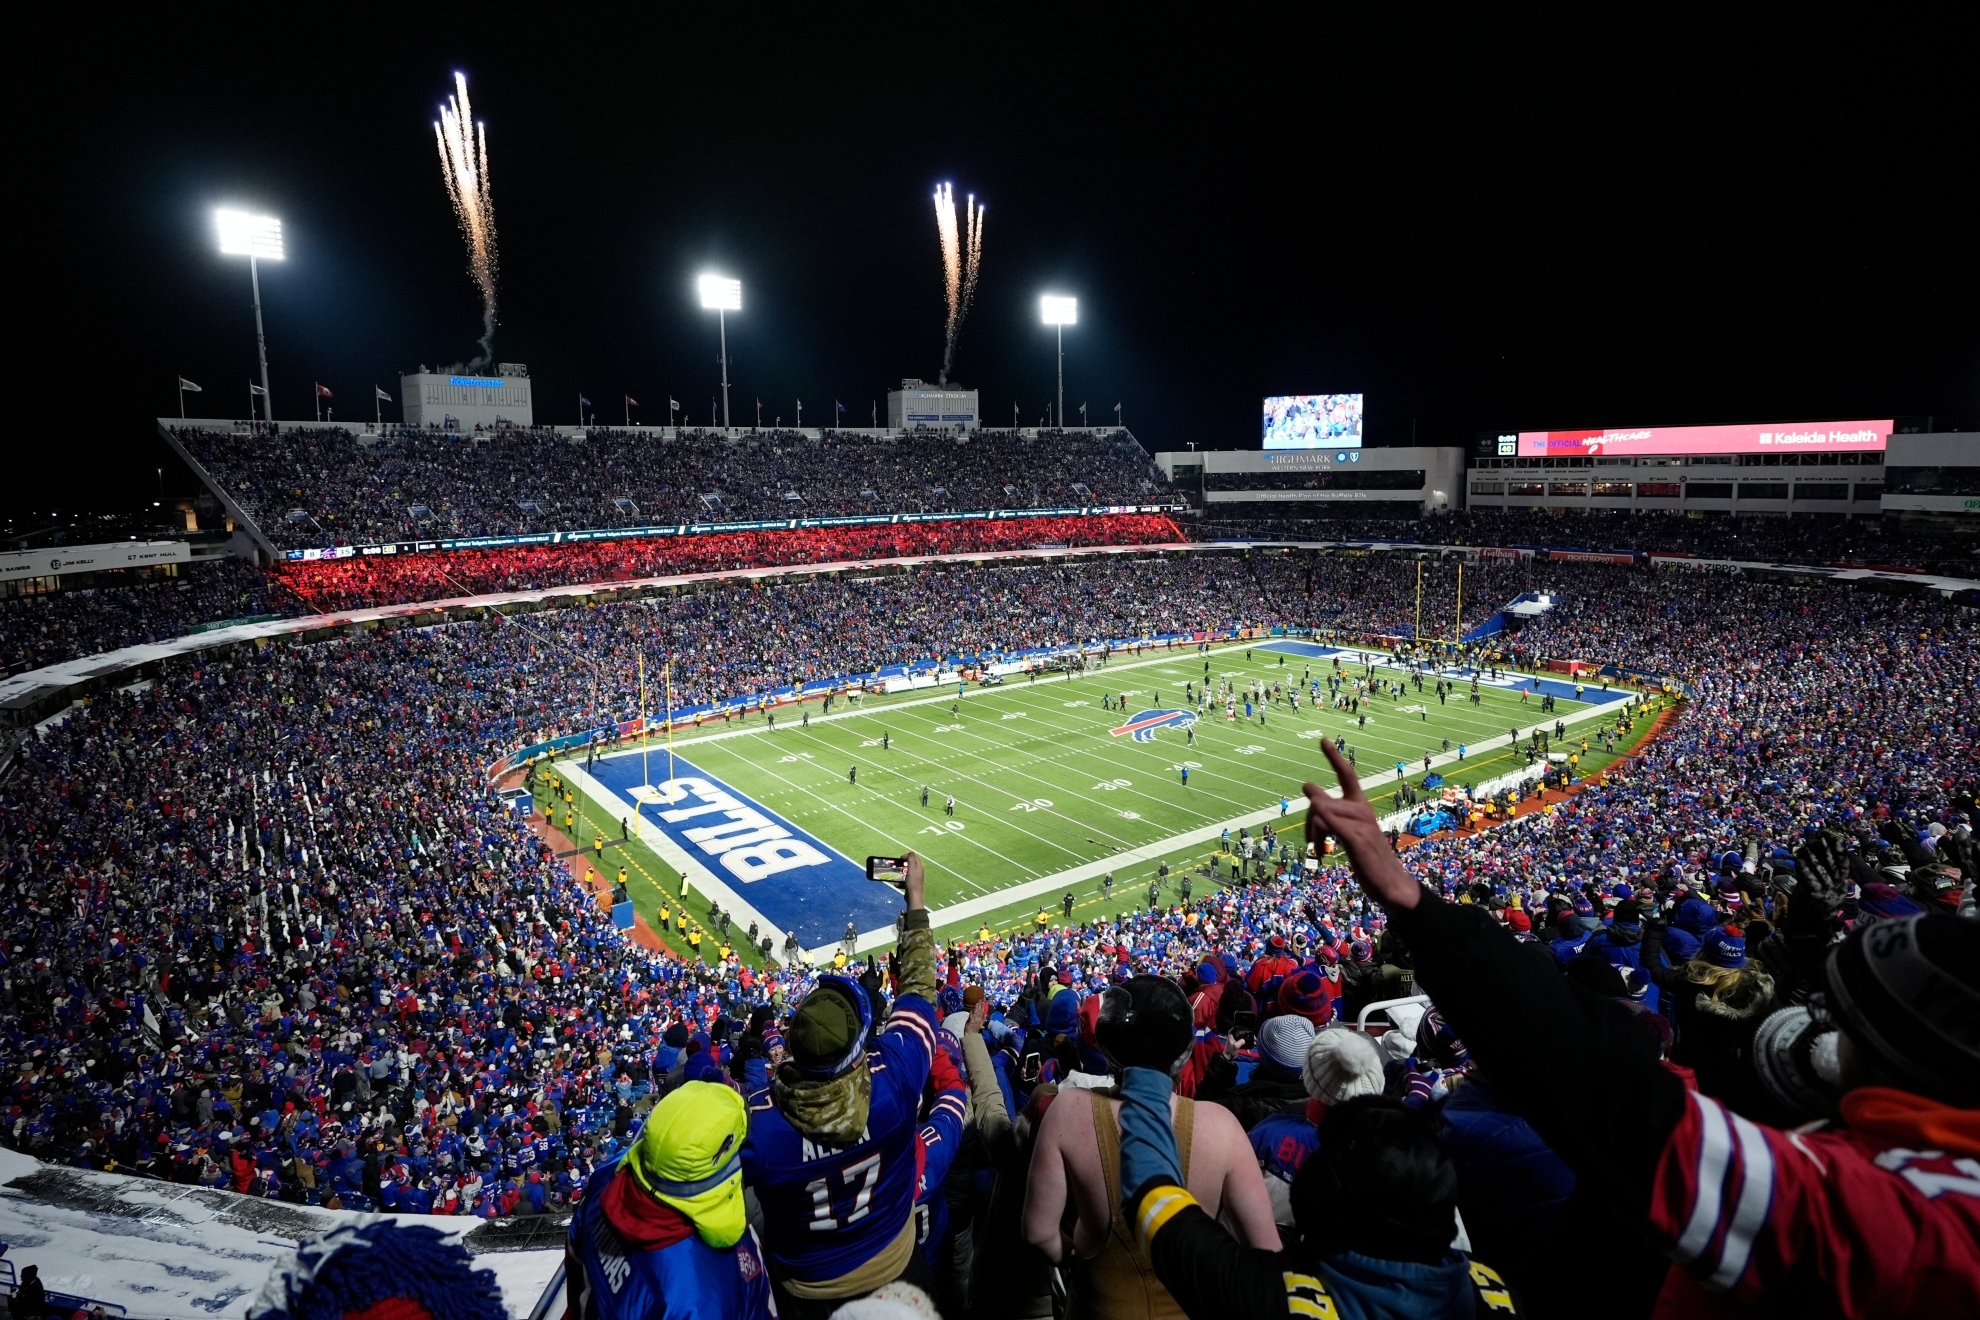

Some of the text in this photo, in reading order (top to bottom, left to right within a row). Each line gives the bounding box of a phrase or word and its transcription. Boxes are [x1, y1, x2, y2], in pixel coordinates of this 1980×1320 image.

[450, 377, 504, 387] ticketmaster
[1582, 431, 1652, 446] HEALTHCARE
[1774, 430, 1878, 444] Kaleida Health
[1500, 444, 1512, 452] 40
[1532, 440, 1546, 448] THE
[1271, 454, 1331, 464] HIGHMARK
[340, 548, 351, 556] 35
[362, 546, 382, 554] 0:00
[1484, 548, 1517, 559] Galbani
[1567, 553, 1614, 563] northtown
[1660, 561, 1692, 569] ZIPPO
[1704, 564, 1738, 572] ZIPPO
[206, 622, 220, 630] M&T
[235, 618, 248, 626] Zone
[1234, 744, 1267, 756] 50
[781, 751, 816, 764] 10
[1102, 778, 1133, 792] 30
[1013, 798, 1054, 813] 20
[625, 777, 833, 884] BILLS
[923, 820, 965, 836] 10
[938, 1031, 960, 1049] BILL
[920, 1126, 942, 1146] 10
[538, 1142, 548, 1151] 58
[802, 1124, 870, 1163] ALLN
[508, 1158, 517, 1168] 95
[805, 1152, 881, 1231] 17
[1469, 1260, 1516, 1314] 17
[1283, 1270, 1341, 1320] 17
